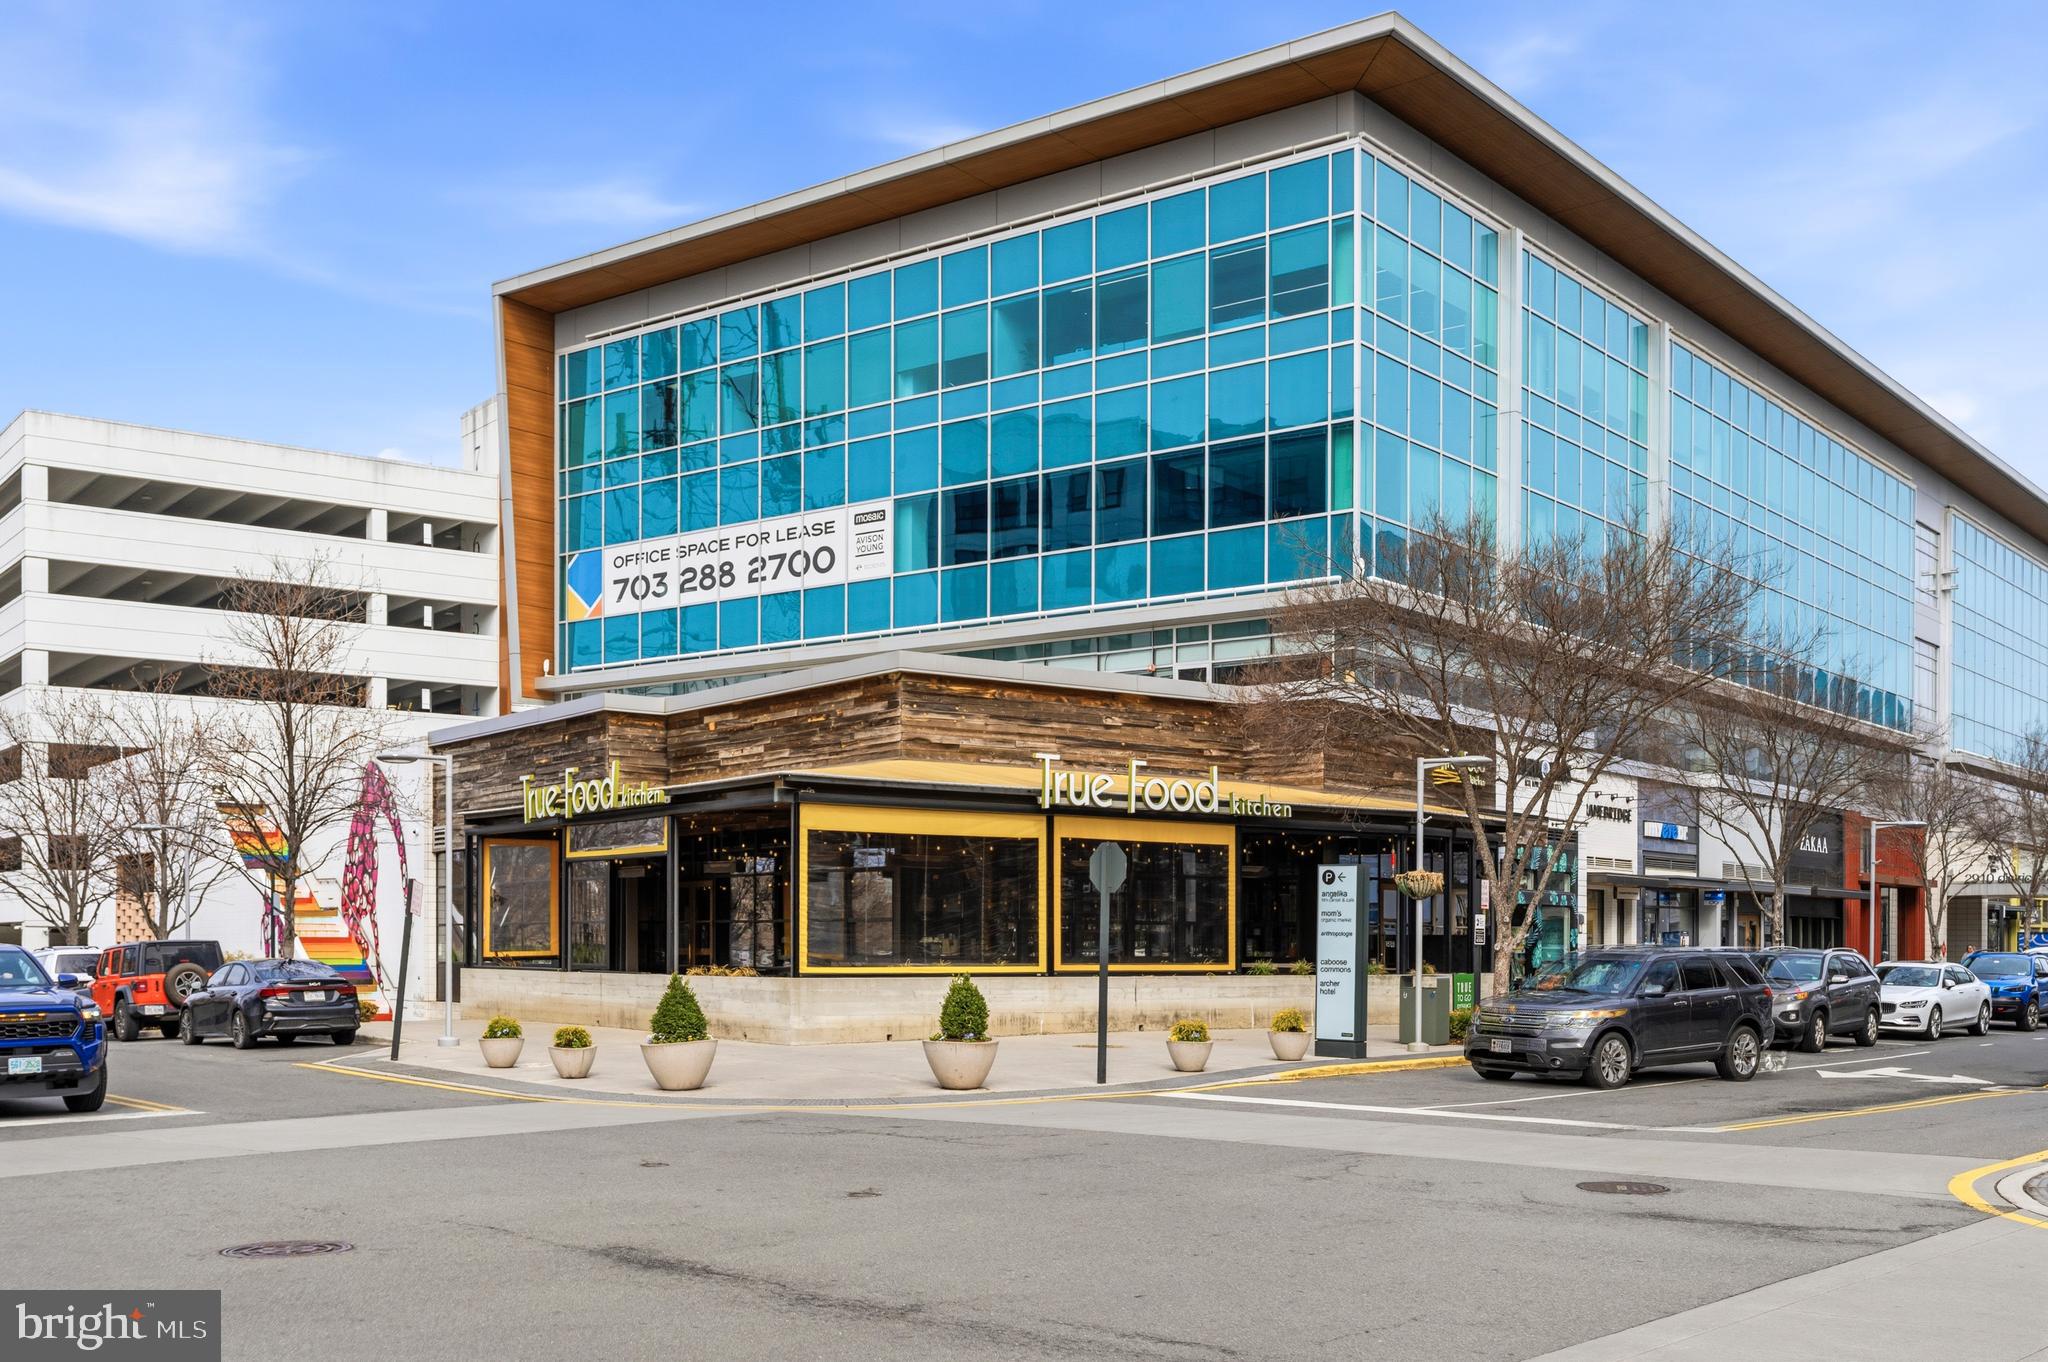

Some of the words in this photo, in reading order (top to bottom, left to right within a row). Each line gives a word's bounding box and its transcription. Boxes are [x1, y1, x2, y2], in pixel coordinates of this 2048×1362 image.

[855, 511, 884, 524] mosaic
[613, 548, 671, 569] OFFICE
[676, 537, 731, 559] SPACE
[735, 531, 771, 549] FOR
[776, 520, 836, 542] LEASE
[856, 533, 884, 545] AVISON
[856, 542, 884, 553] YOUNG
[612, 571, 668, 604] 703
[679, 560, 736, 594] 288
[747, 545, 836, 584] 2700
[1032, 752, 1115, 809] True
[1127, 758, 1219, 814] Food
[1229, 791, 1293, 818] kitchen
[519, 773, 562, 824] True
[565, 759, 621, 819] Food
[621, 781, 666, 807] kitchen
[1964, 873, 1995, 884] 2910
[1321, 890, 1348, 899] angelika
[1320, 930, 1353, 938] anthropologie
[1320, 958, 1348, 966] caboose
[1456, 982, 1472, 993] TRUE
[1457, 994, 1464, 1002] TO
